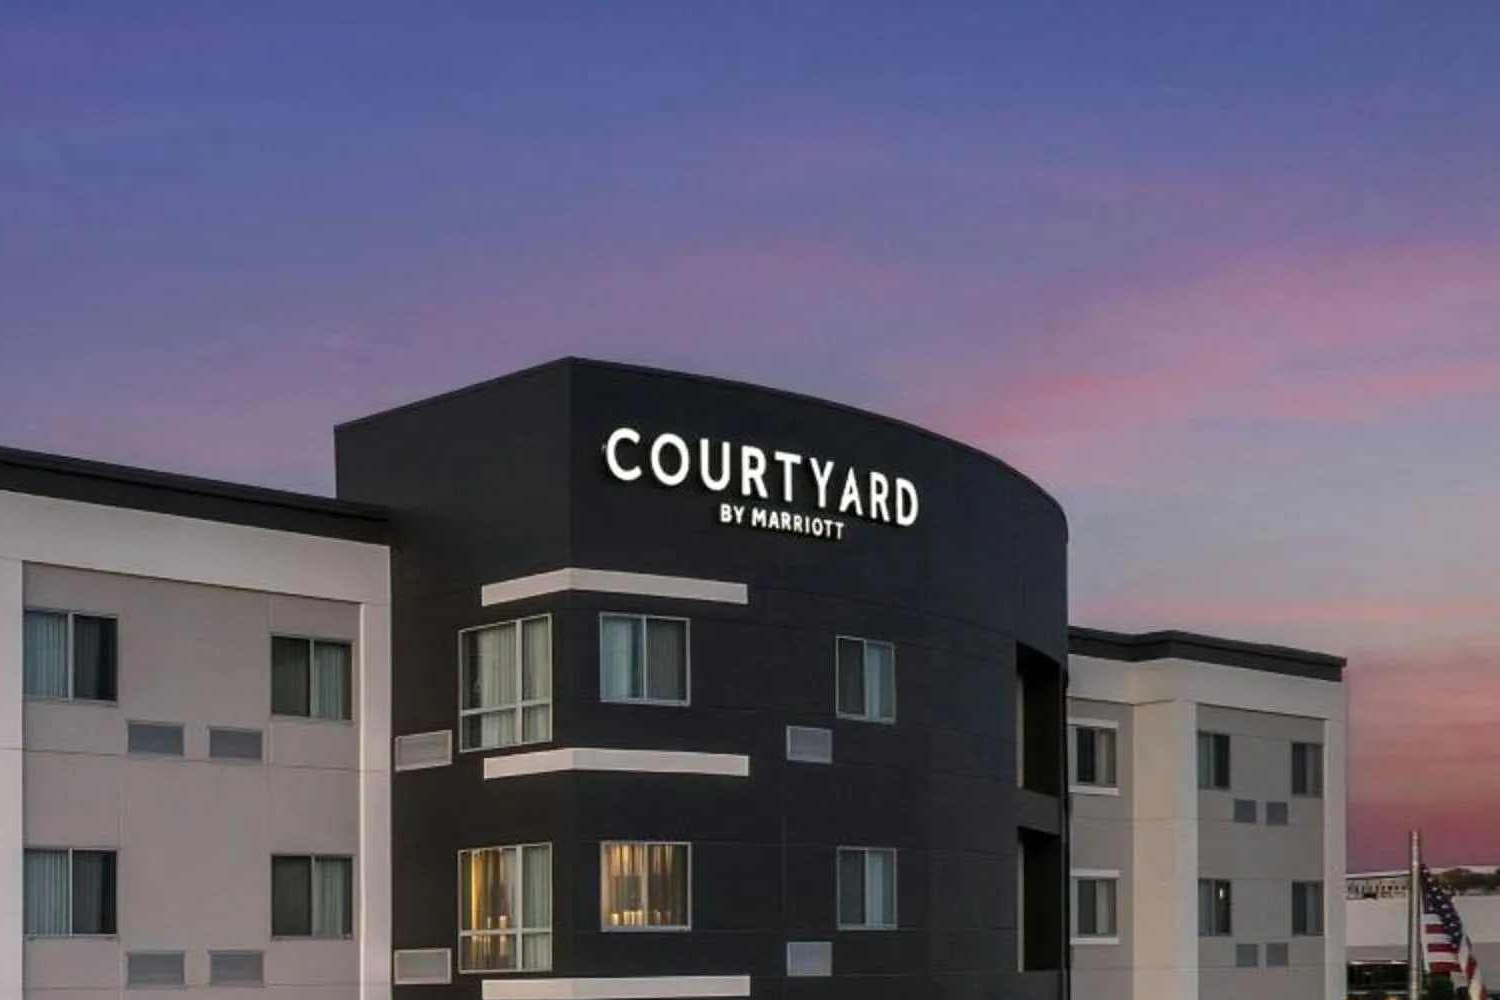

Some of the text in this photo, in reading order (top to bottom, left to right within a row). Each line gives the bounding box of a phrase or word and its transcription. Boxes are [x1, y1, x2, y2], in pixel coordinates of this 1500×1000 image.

[605, 427, 919, 526] COURTYARD
[720, 503, 845, 540] BY MARRIOTT
